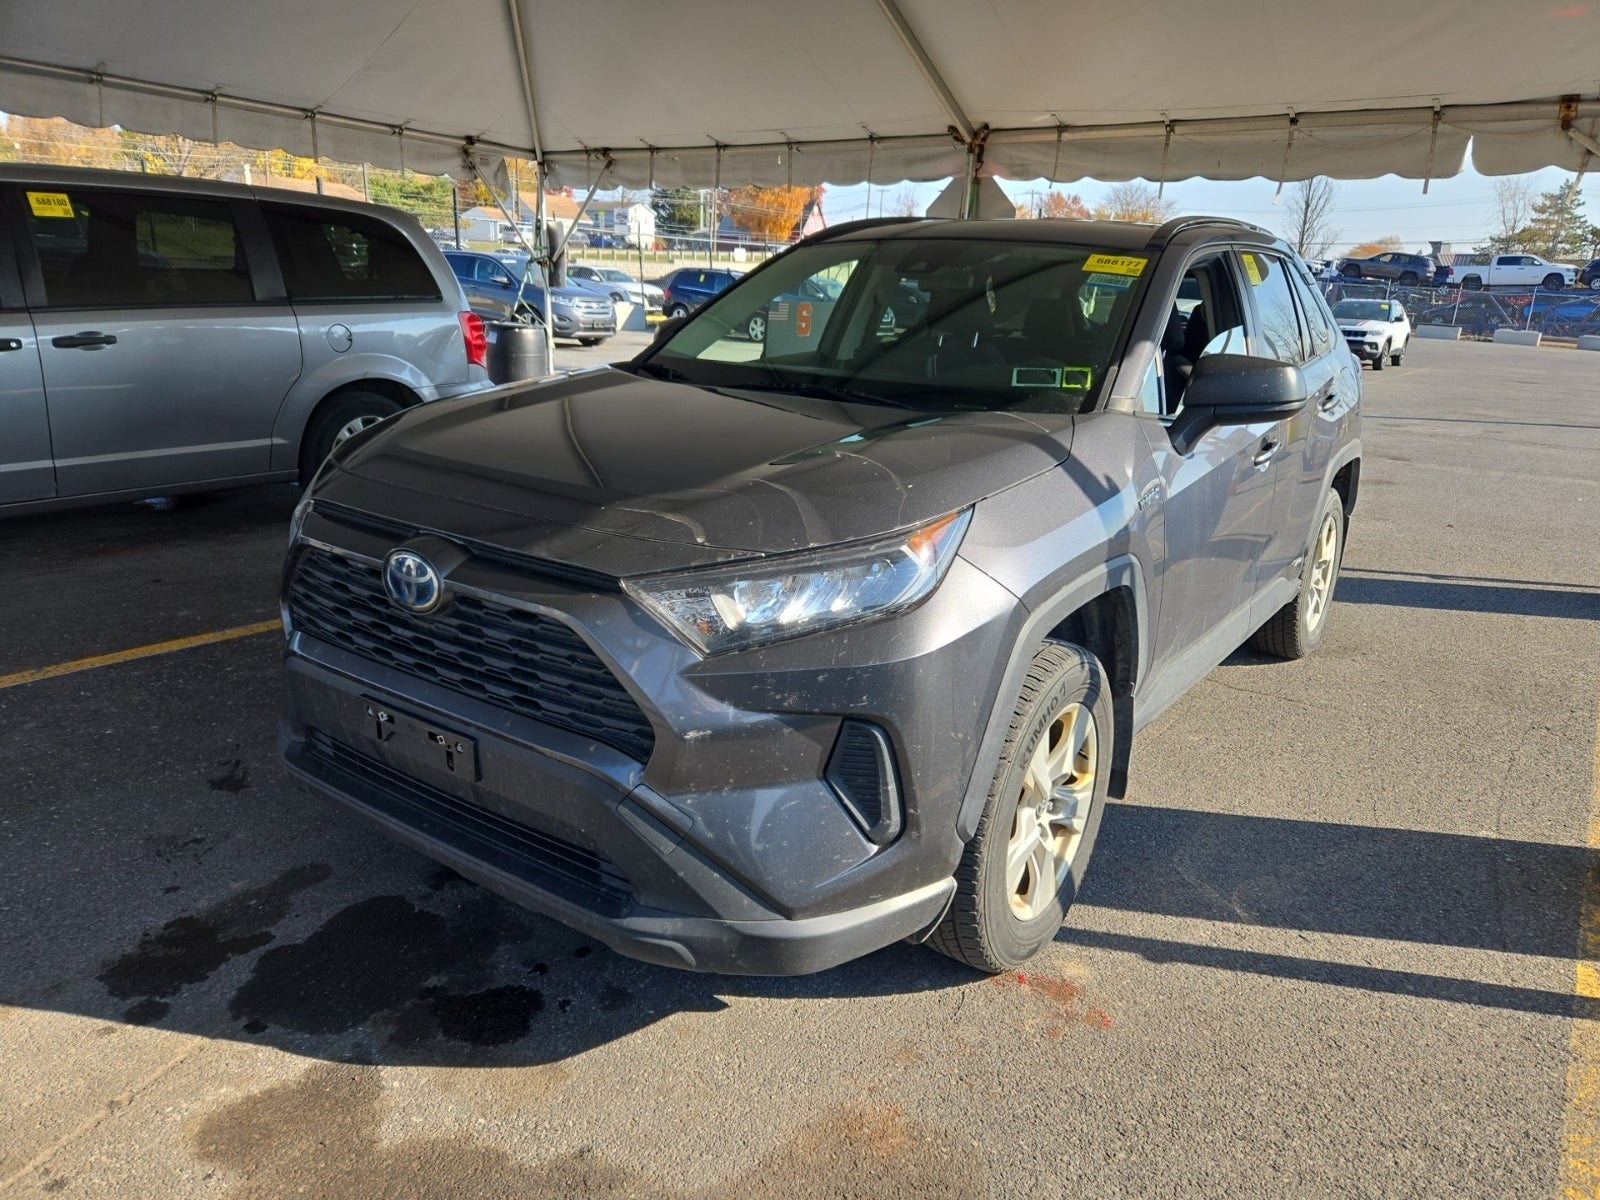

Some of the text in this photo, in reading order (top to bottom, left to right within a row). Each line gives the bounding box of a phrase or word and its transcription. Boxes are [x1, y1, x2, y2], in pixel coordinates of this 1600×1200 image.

[35, 197, 68, 207] 688180
[1096, 258, 1141, 268] 688177
[796, 302, 813, 337] S
[1020, 696, 1060, 771] KUMHO
